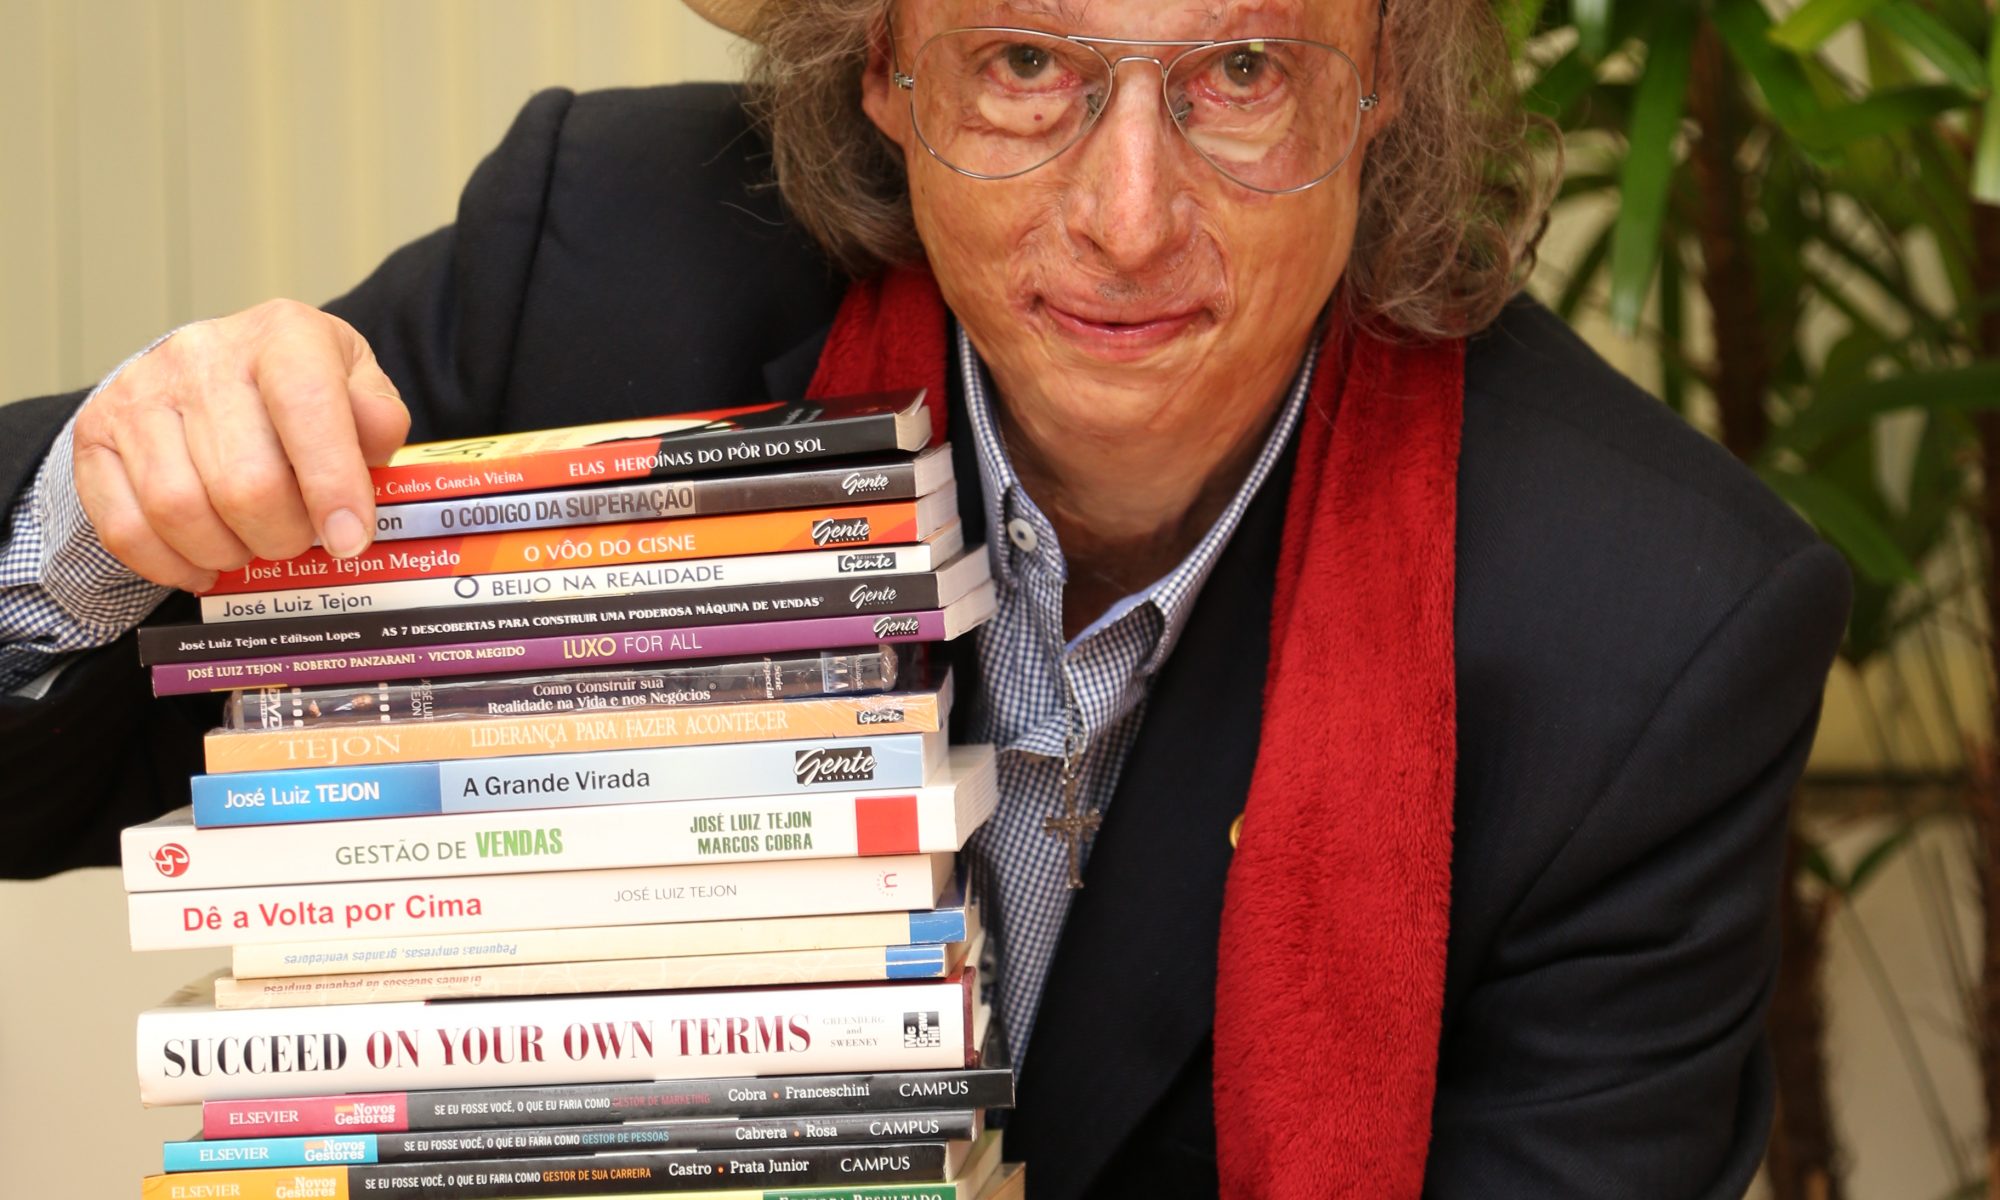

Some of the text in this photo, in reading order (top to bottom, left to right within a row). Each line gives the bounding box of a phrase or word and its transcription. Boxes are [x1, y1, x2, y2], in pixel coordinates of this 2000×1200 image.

[569, 438, 826, 477] ELAS HEROÍNAS DO PÔR DO SOL
[842, 472, 889, 496] Gente
[441, 486, 694, 528] O CÓDIGO DA SUPERAÇÃO
[812, 518, 871, 546] Gente
[523, 535, 696, 562] O VÔO DO CISNE
[244, 550, 461, 583] José Luiz Tejon Megido
[841, 553, 893, 572] Gente
[454, 565, 724, 599] O BEIJO NA REALIDADE
[223, 593, 372, 617] José Luiz Tejon
[849, 584, 898, 609] Gente
[382, 599, 769, 637] AS 7 DESCOBERTAS PARA CONSTRUIR UMA PODEROSA MÁQUINA DE
[873, 616, 919, 639] Gente
[178, 630, 361, 652] José Luiz Tejon e Edilson Lopes
[563, 633, 702, 659] LUXO FOR ALL
[187, 646, 526, 681] JOSÉ LUIZ TEJON ROBERTO PANZARANI VICTOR MEGIDO
[533, 678, 664, 697] Como Construir sua
[488, 688, 711, 714] Realidade na Vida e nos Negócios
[471, 710, 789, 748] LIDERANÇA PARA FAZER ACONTECER
[279, 734, 401, 764] TEJON
[794, 747, 876, 786] Gente
[463, 768, 650, 797] A Grande Virada
[224, 782, 380, 809] José Luiz TEJON
[690, 811, 812, 833] JOSÉ LUIZ TEJON
[336, 828, 563, 865] GESTÃO DE VENDAS
[697, 833, 813, 855] MARCOS COBRA
[614, 884, 737, 903] JOSÉ LUIZ TEJON
[183, 894, 482, 932] Dê a Volta por Cima
[352, 947, 397, 961] grandes
[846, 1026, 862, 1035] and
[163, 1015, 811, 1078] SUCCEED ON YOUR OWN TERMS
[830, 1038, 879, 1048] SWEENEY
[728, 1084, 870, 1102] Cobra Franceschini
[899, 1081, 969, 1097] CAMPUS
[229, 1110, 299, 1125] ELSEVIER
[335, 1113, 394, 1125] Gestores
[353, 1103, 396, 1115] Novos
[736, 1124, 837, 1140] Cabrera Rosa
[870, 1120, 939, 1136] CAMPUS
[323, 1139, 365, 1151] Novos
[404, 1131, 669, 1152] SE EU FOSSE VOCÊ, O QUE EU FARIA COMO GESTOR DE PESSOAS
[199, 1147, 269, 1162] ELSEVIER
[304, 1150, 364, 1162] Gestores
[840, 1156, 911, 1172] CAMPUS
[365, 1167, 651, 1189] SE EU FOSSE VOCÊ, O QUE EU FARIA COMO GESTOR DE SUA CARREIRA
[669, 1158, 809, 1177] Castro Prata Junior
[171, 1184, 240, 1199] ELSEVIER
[276, 1186, 336, 1199] Gestores
[295, 1177, 336, 1188] Novos
